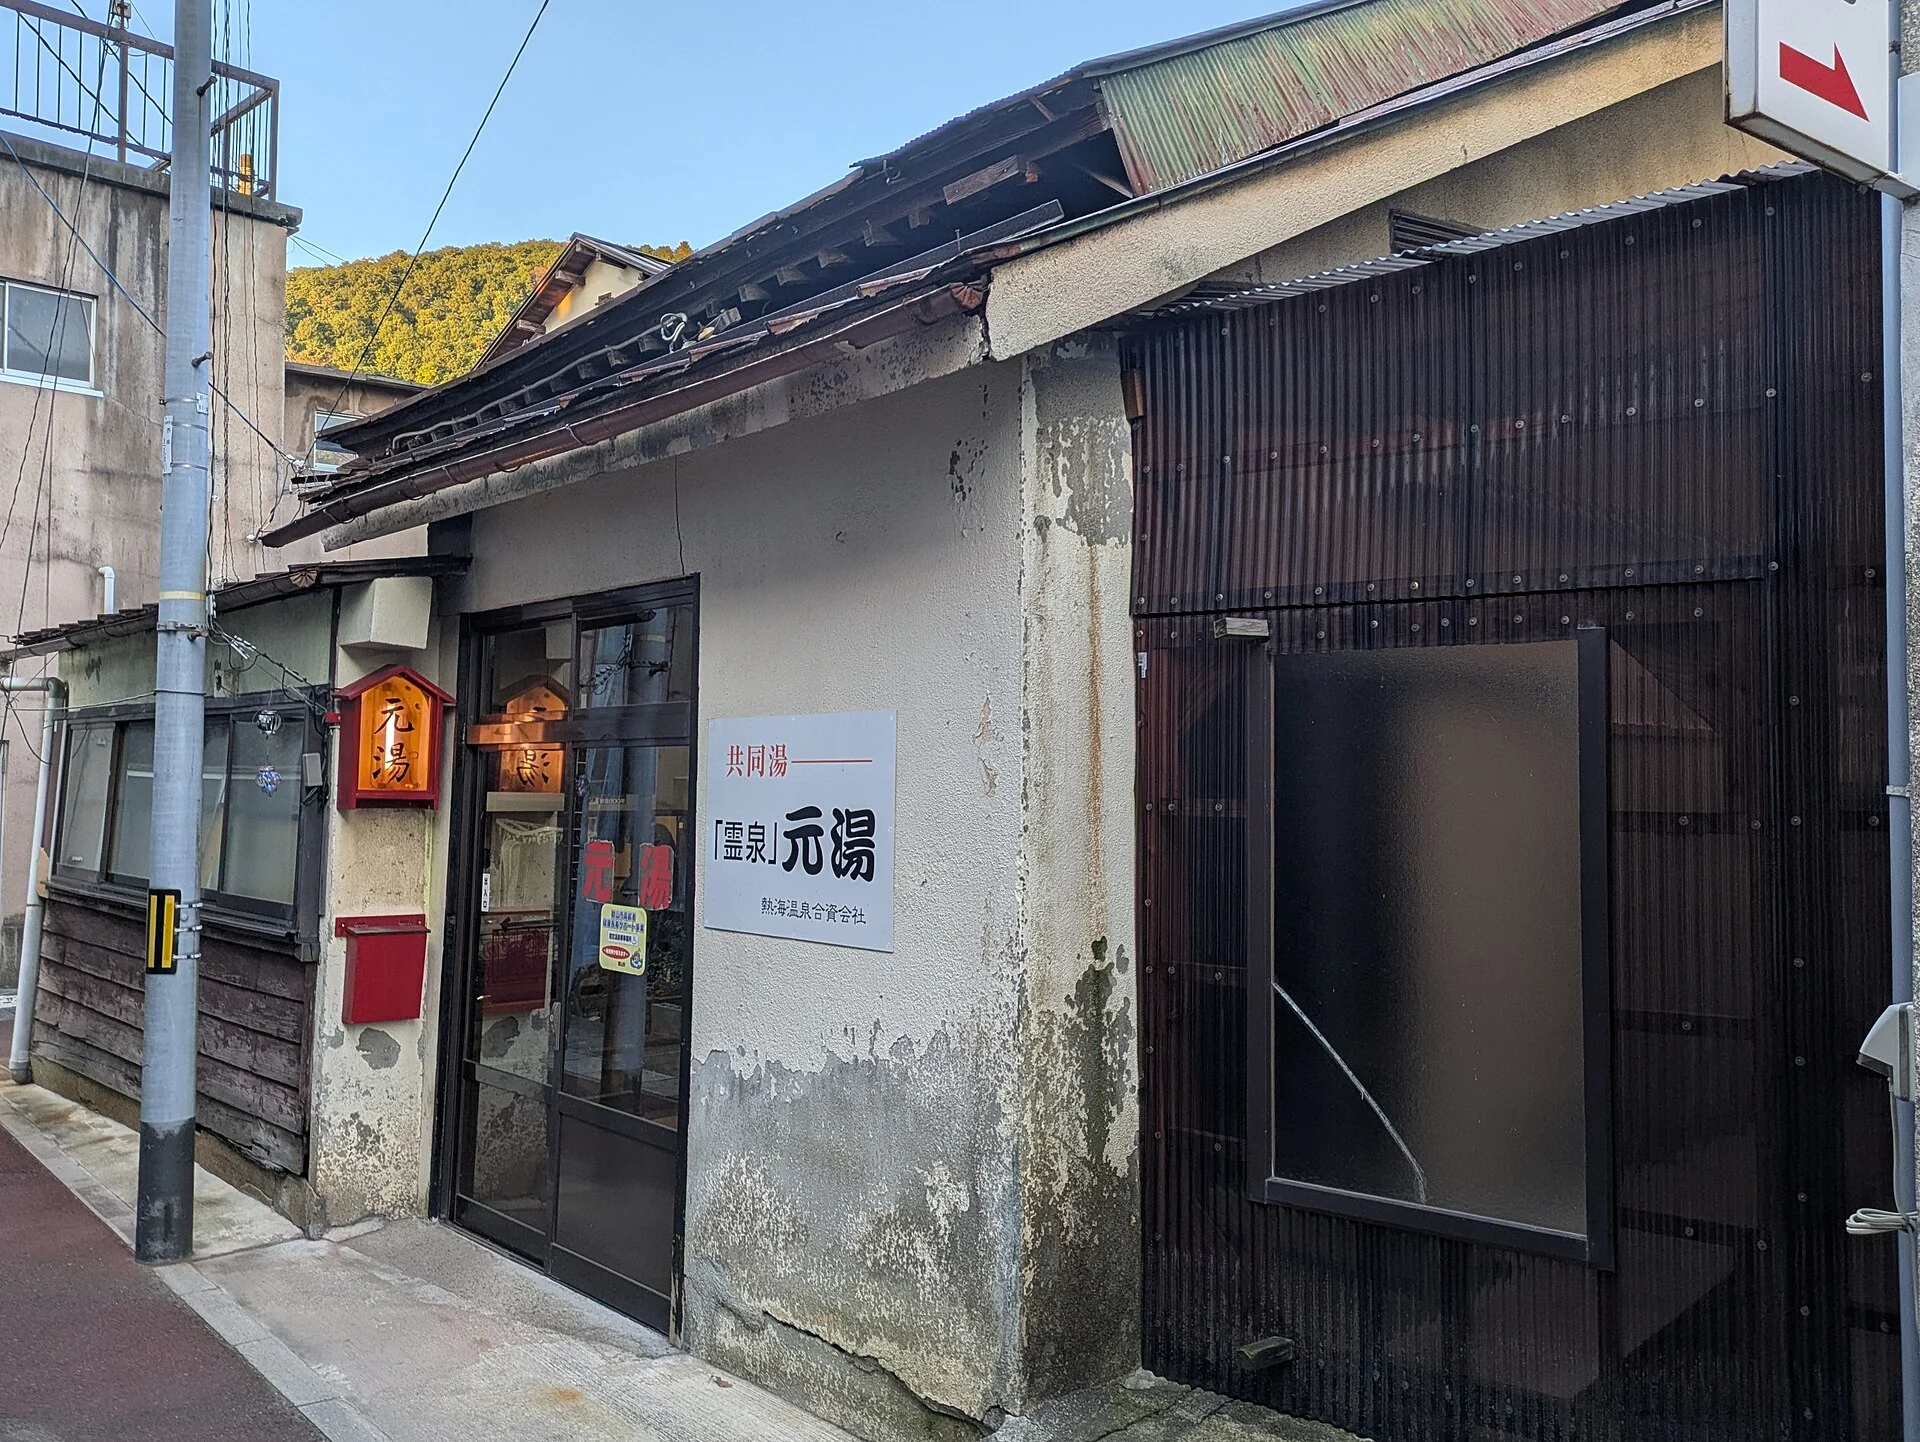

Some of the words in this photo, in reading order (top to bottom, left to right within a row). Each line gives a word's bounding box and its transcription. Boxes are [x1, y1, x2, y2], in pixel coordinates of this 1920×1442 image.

[372, 697, 416, 785] 元湯
[726, 743, 788, 778] 共同湯
[761, 897, 867, 925] 熱海温泉合資会社
